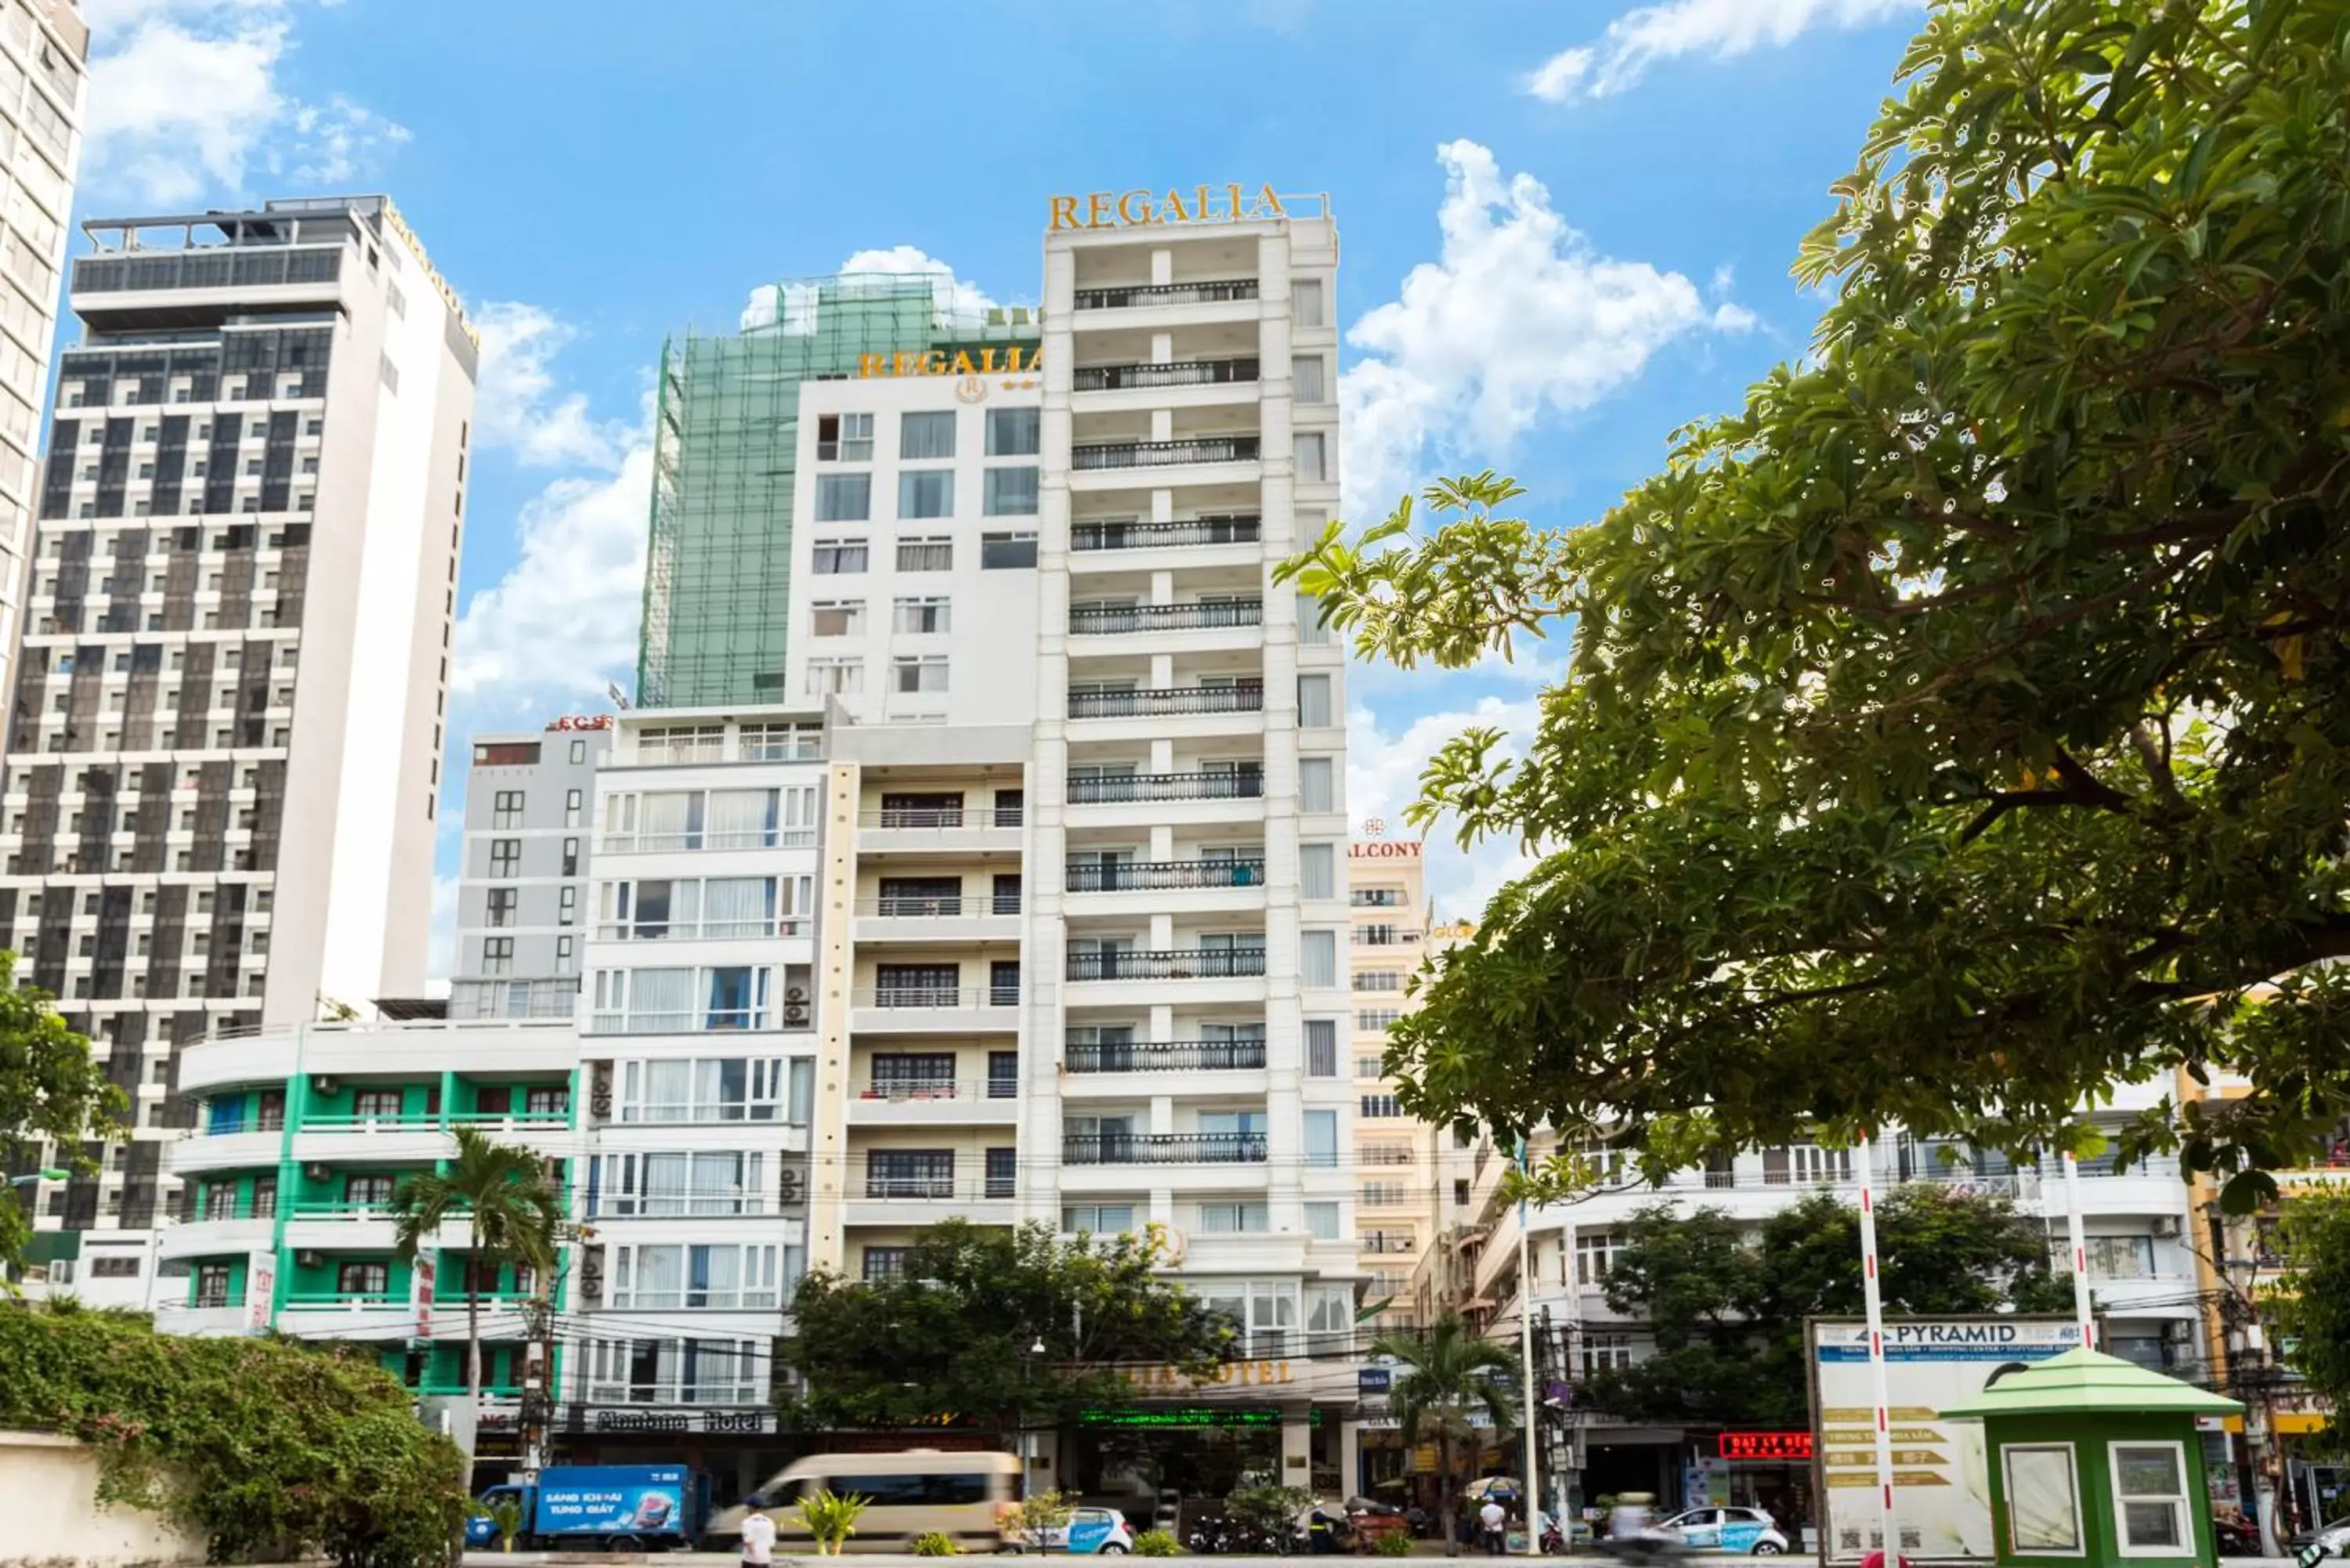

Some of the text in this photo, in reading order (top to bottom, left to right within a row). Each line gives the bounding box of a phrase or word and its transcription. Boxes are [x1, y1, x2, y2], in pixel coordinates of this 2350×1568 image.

[1050, 182, 1285, 229] REGALIA
[856, 345, 1044, 378] REGALIA
[1896, 1325, 2016, 1342] PYRAMID
[1213, 1360, 1293, 1385] OTEL
[704, 1411, 762, 1432] Hotel
